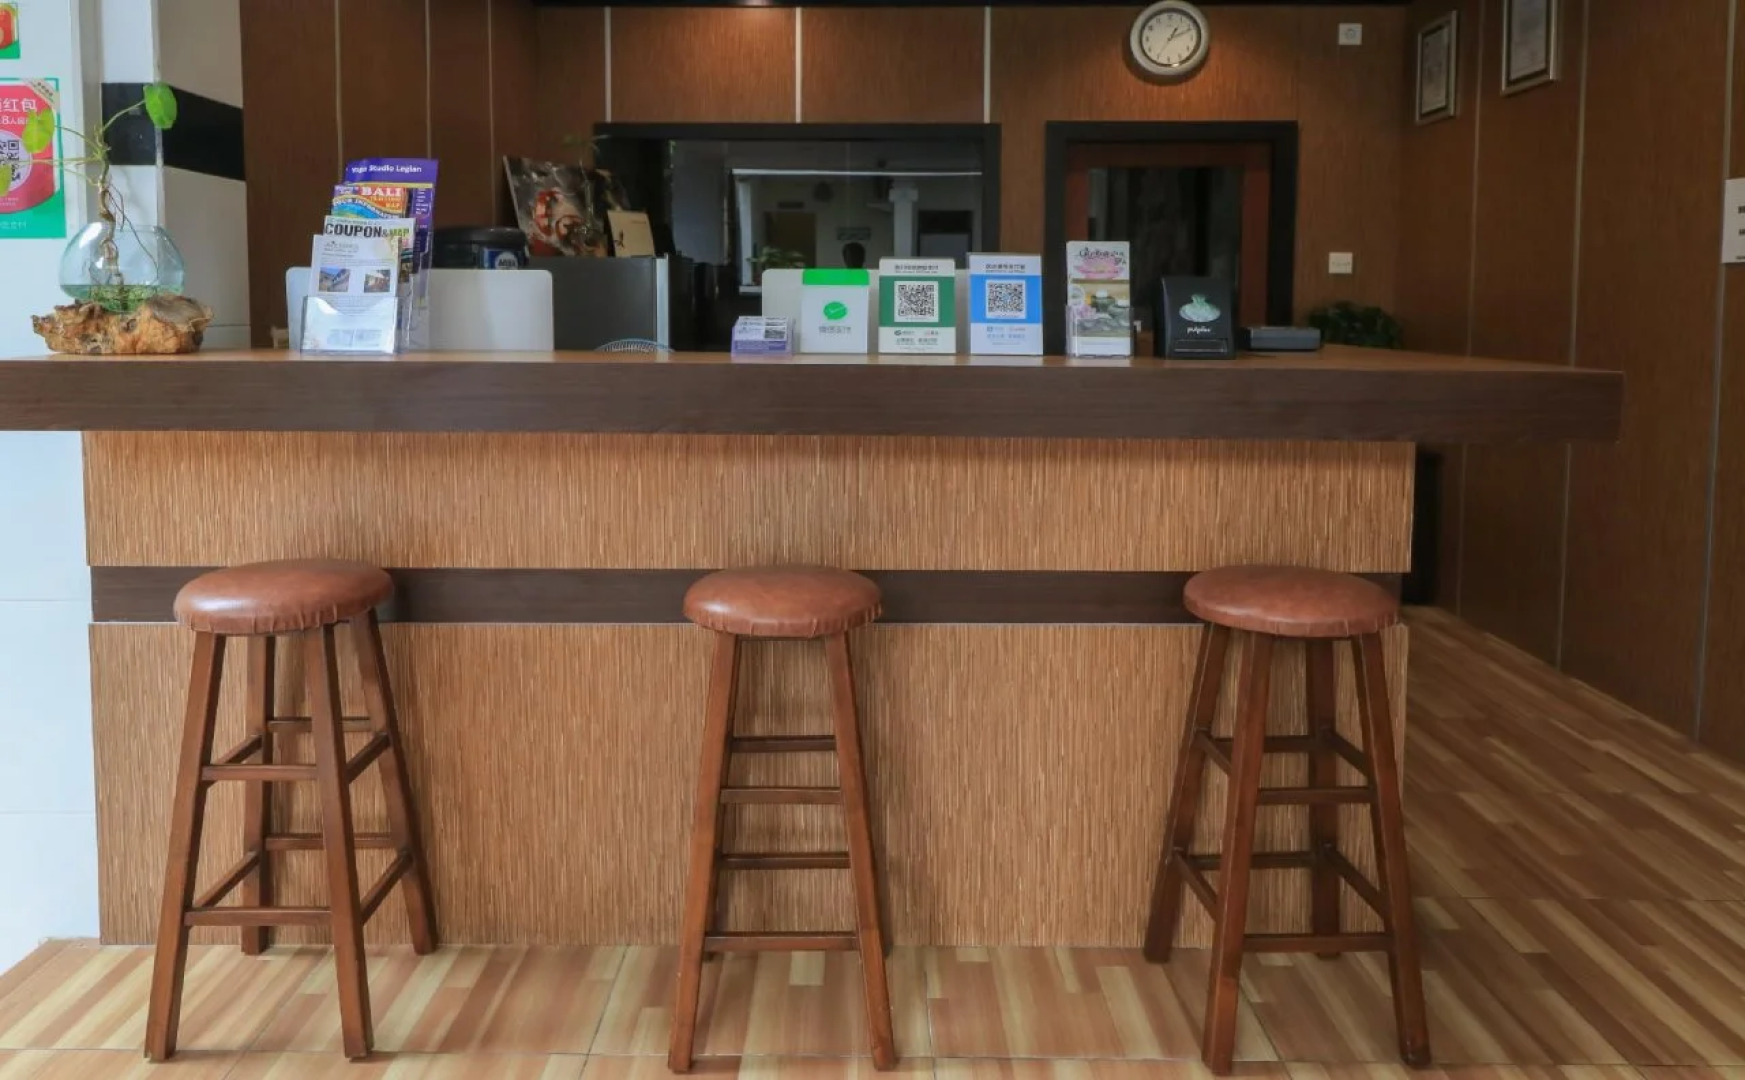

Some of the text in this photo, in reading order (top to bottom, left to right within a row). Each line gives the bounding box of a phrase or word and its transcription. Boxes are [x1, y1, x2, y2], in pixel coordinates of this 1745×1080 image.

[0, 97, 37, 112] 红包
[369, 164, 394, 172] Studio
[361, 186, 401, 195] BALI
